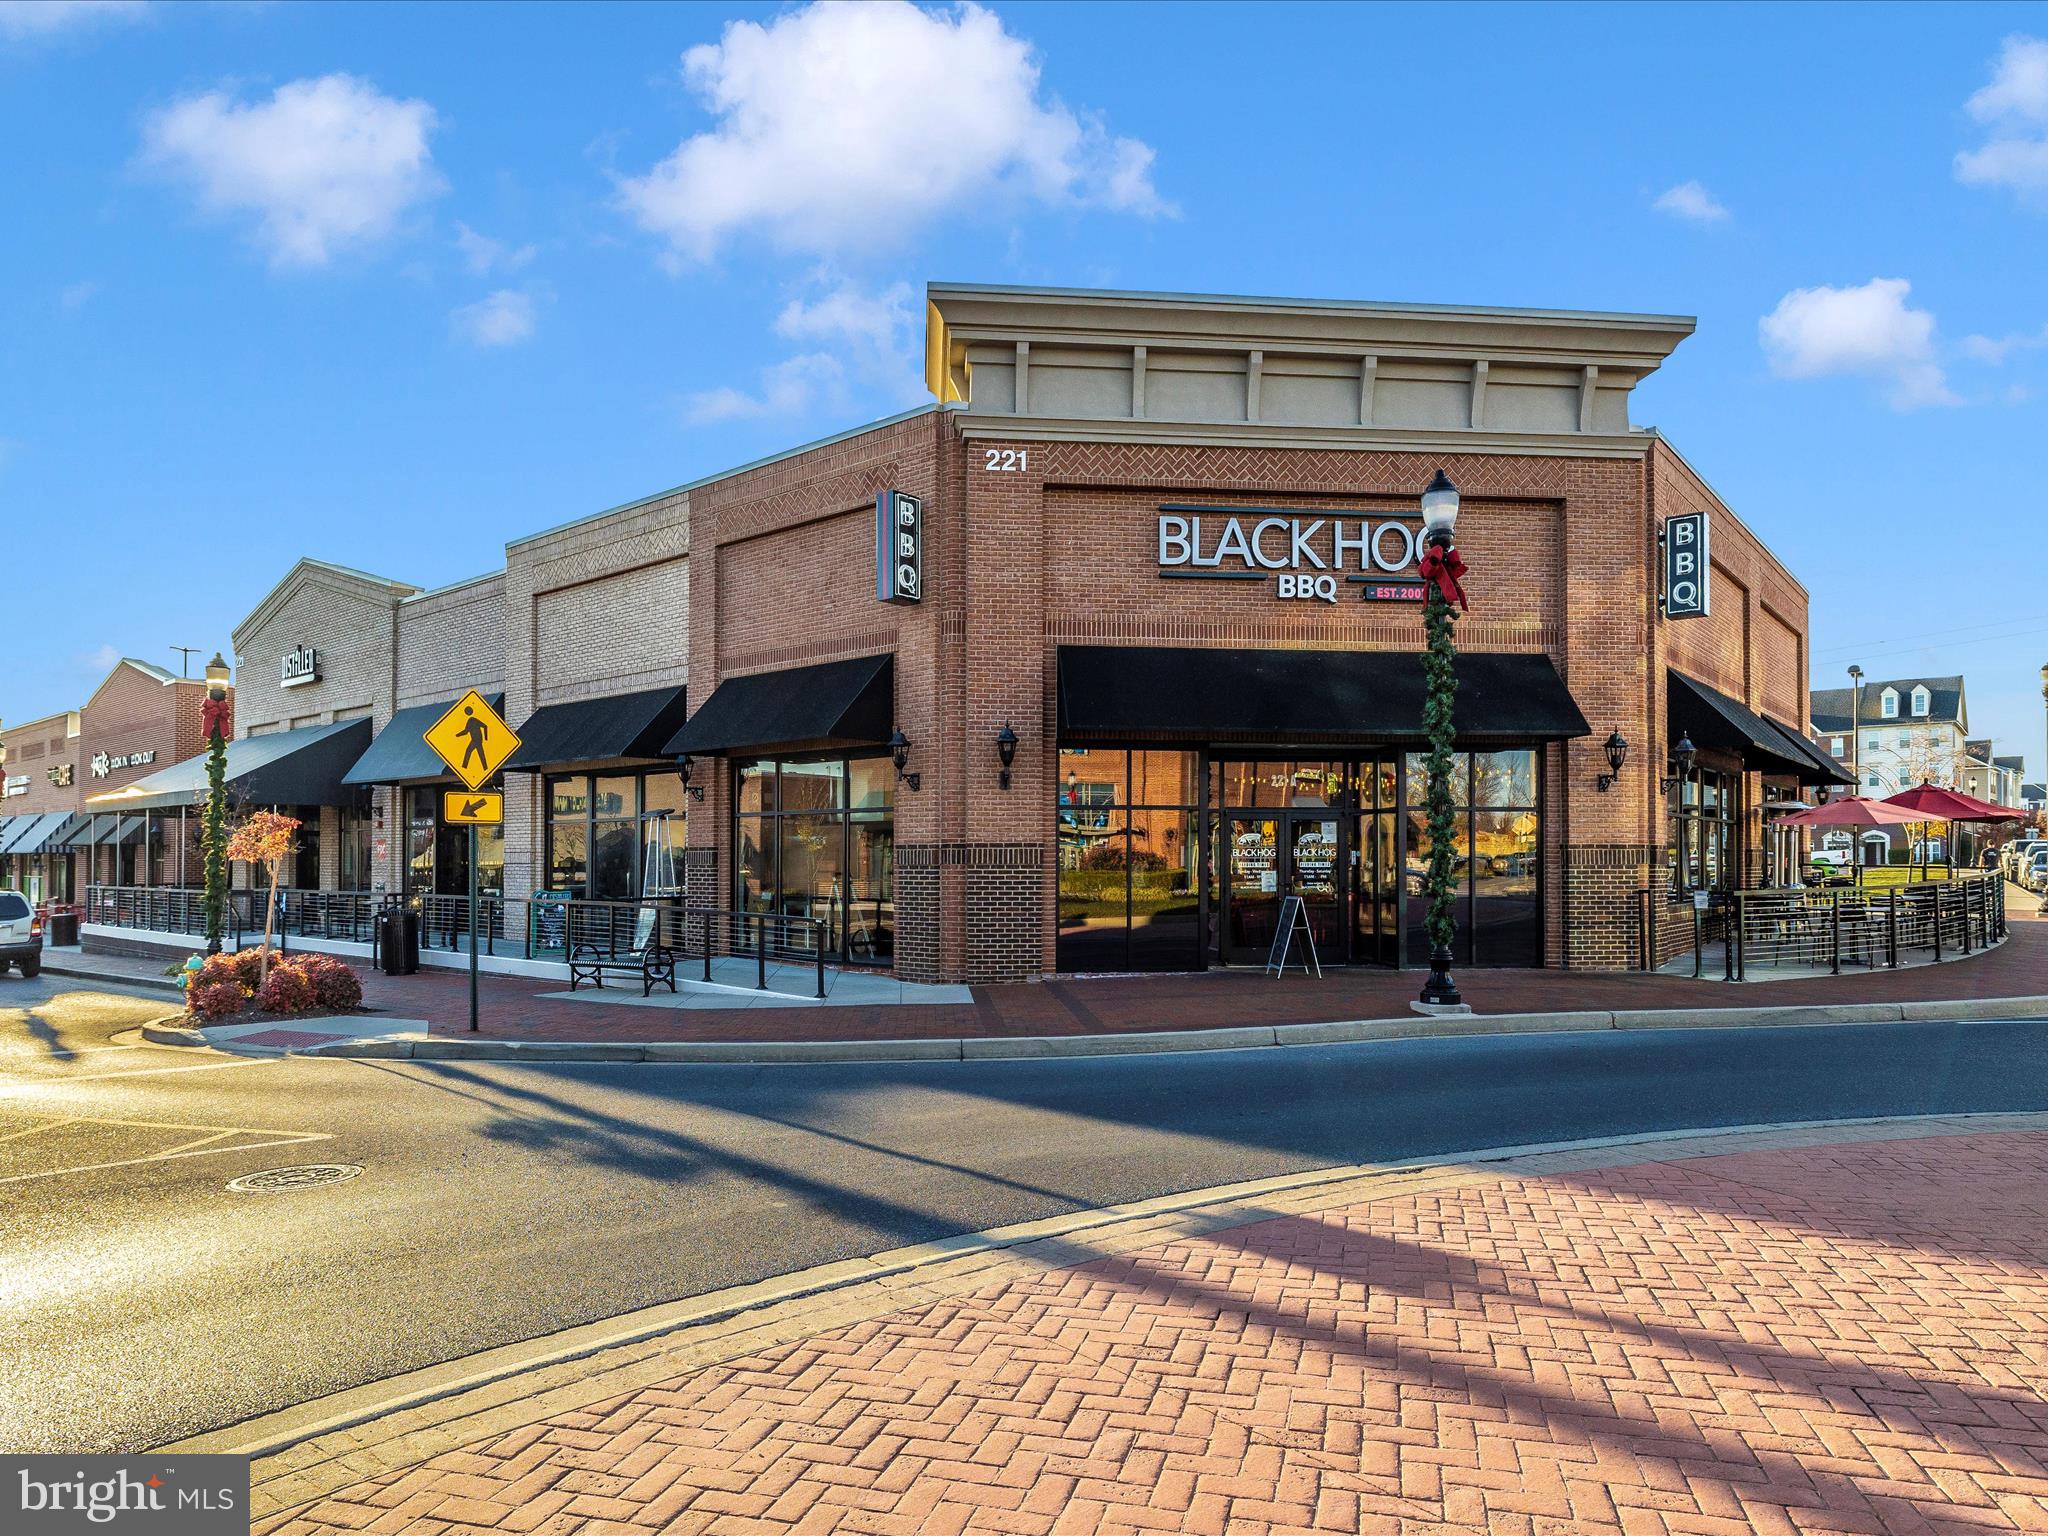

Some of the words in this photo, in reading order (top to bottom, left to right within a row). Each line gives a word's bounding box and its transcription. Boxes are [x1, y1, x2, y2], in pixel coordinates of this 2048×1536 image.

[985, 449, 1027, 472] 221
[899, 500, 916, 595] BBQ
[1673, 522, 1698, 607] BBQ
[1279, 575, 1337, 604] BBQ
[1376, 587, 1400, 599] EST.
